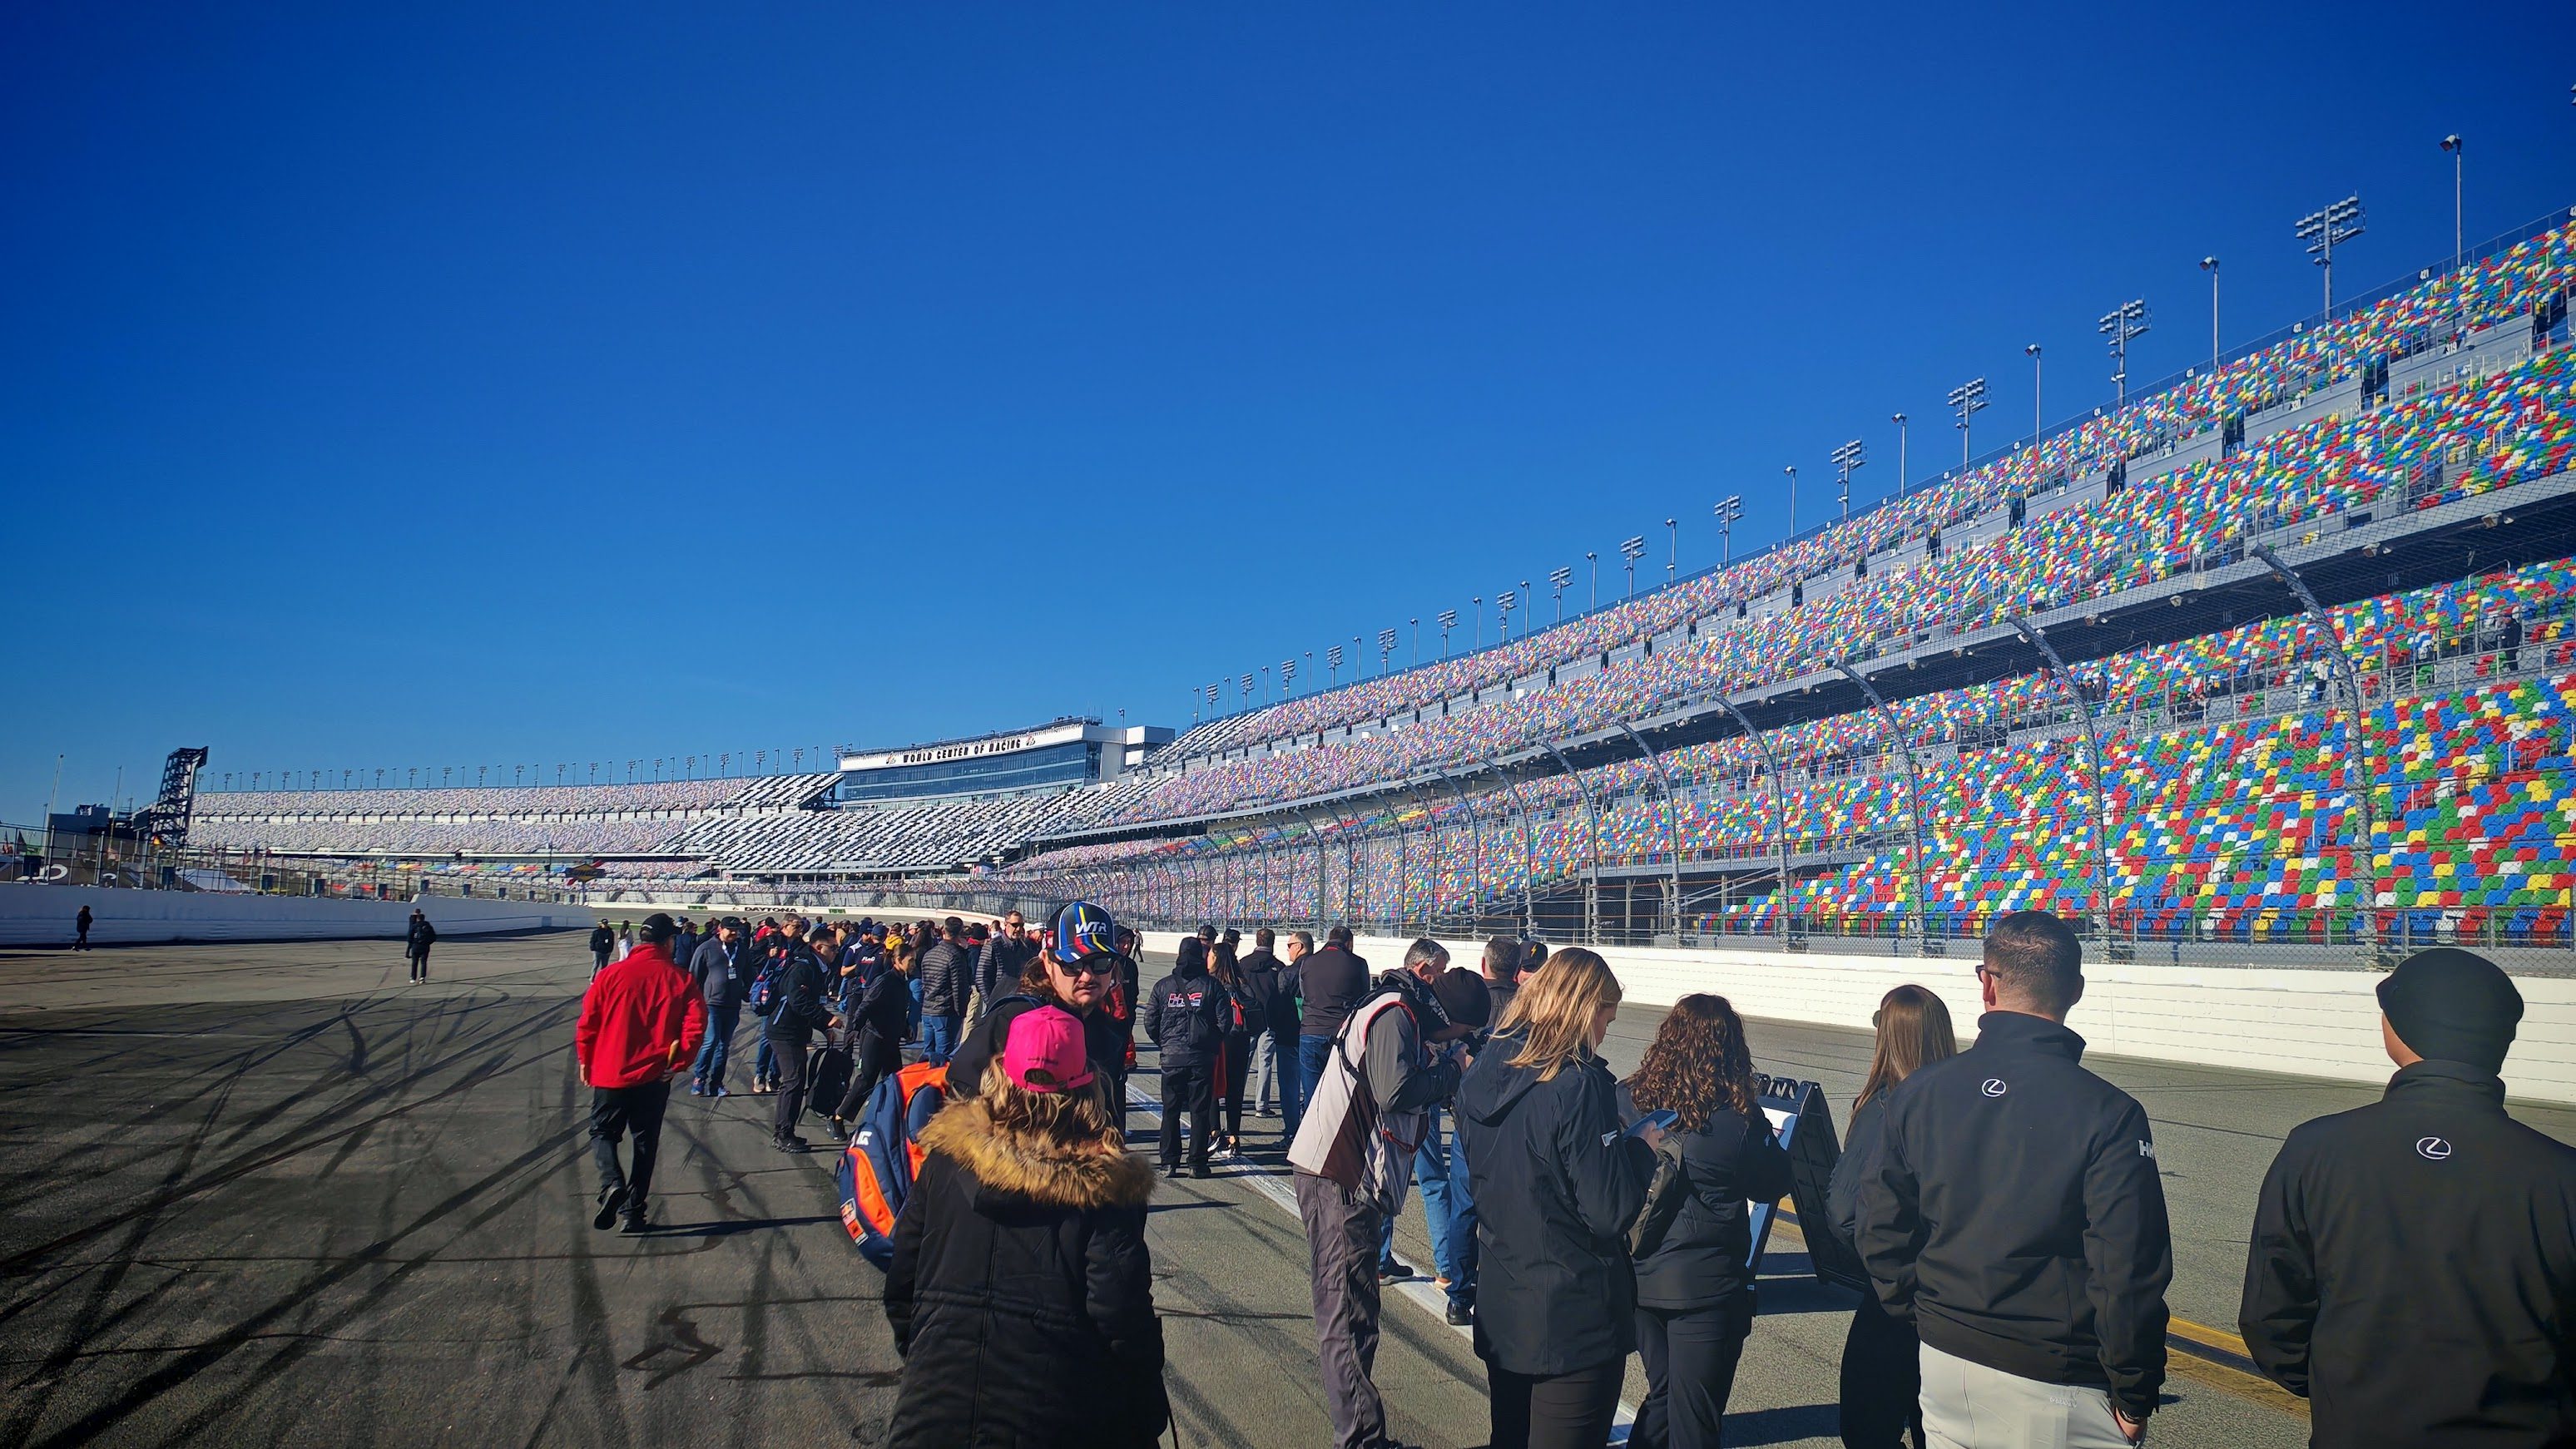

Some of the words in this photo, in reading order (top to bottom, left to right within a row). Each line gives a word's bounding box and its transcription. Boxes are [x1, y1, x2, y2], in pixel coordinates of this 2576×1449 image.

[2445, 341, 2458, 355] 319
[903, 752, 933, 764] WORLD
[936, 747, 969, 759] CENTER
[973, 744, 985, 755] OF
[988, 739, 1022, 754] RACING
[744, 906, 798, 914] DAYTONA
[1074, 921, 1107, 934] WTR
